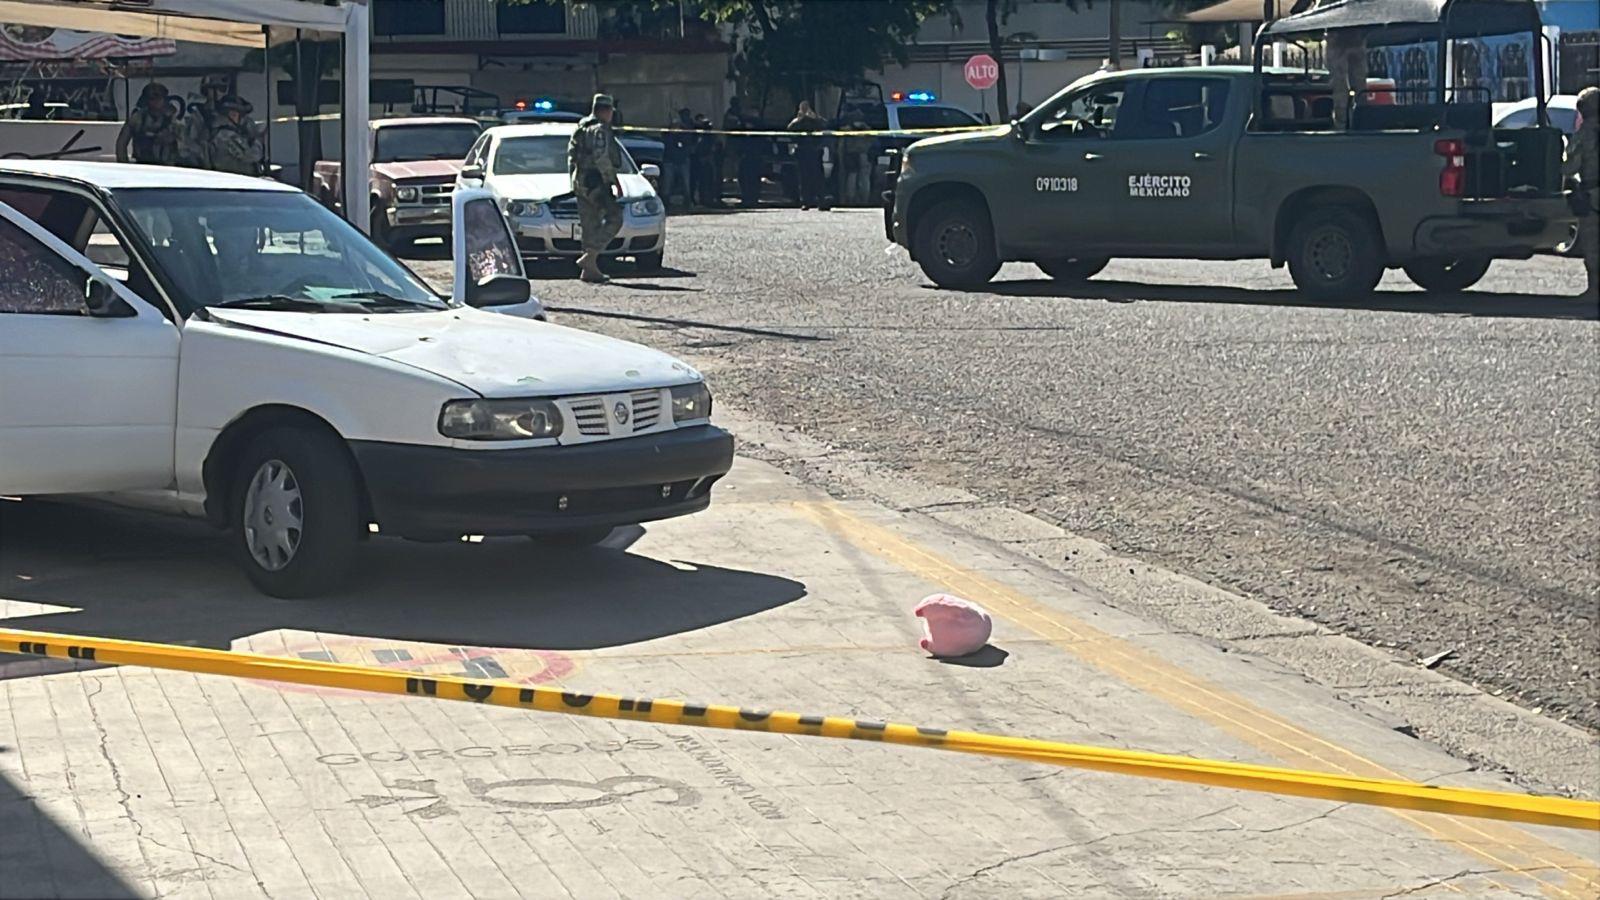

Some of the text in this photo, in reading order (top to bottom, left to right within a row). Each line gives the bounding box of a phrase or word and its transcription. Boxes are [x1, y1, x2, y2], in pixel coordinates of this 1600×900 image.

[968, 65, 996, 79] ALTO
[1036, 177, 1078, 191] 0910318
[1128, 173, 1191, 187] EJÉRCITO
[1130, 187, 1190, 197] MEXICANO
[316, 738, 663, 765] GORGEOUS
